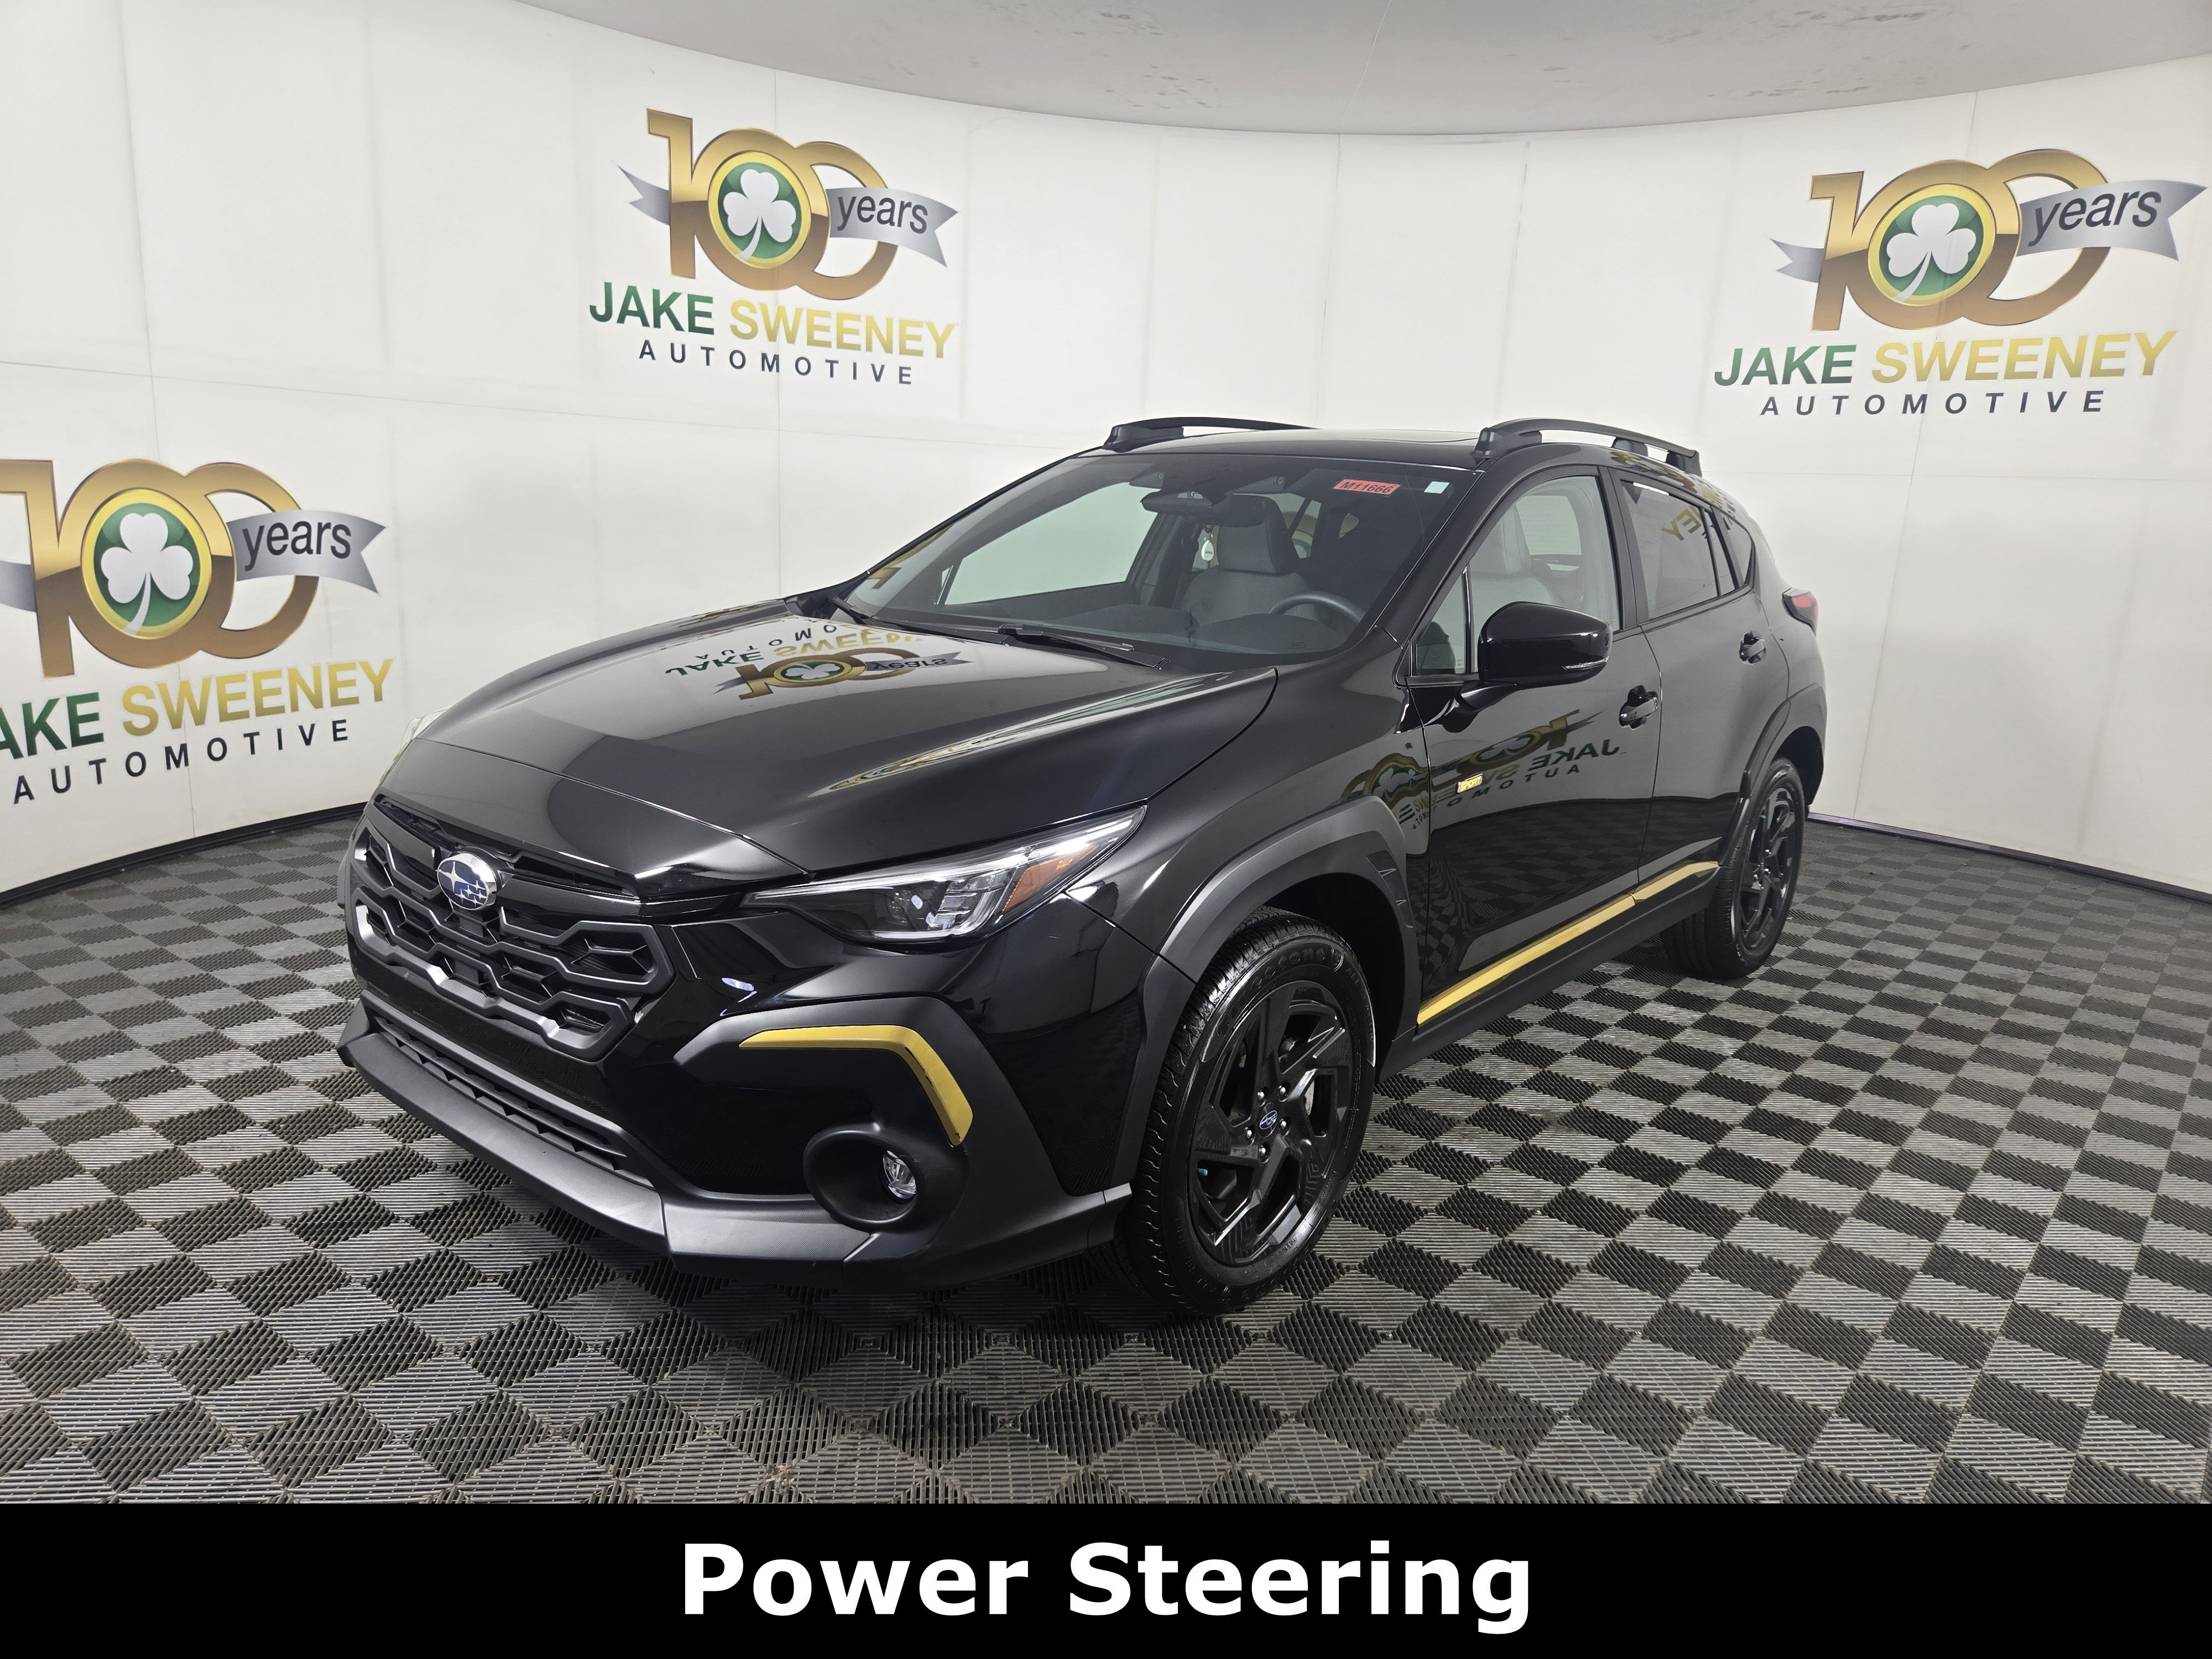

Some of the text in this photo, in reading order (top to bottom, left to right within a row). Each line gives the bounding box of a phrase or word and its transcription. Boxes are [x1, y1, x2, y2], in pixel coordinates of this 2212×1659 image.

[646, 108, 928, 301] 100 years
[1810, 148, 2162, 332] 100 years
[589, 281, 956, 359] JAKE SWEENEY
[639, 340, 912, 385] AUTOMOTIVE
[1714, 331, 2178, 386] JAKE SWEENEY
[1760, 390, 2105, 416] AUTOMOTIVE
[1340, 481, 1395, 494] M11666
[242, 520, 352, 572] years
[0, 658, 394, 760] AKE SWEENEY
[13, 719, 348, 805] AUTOMOTIVE
